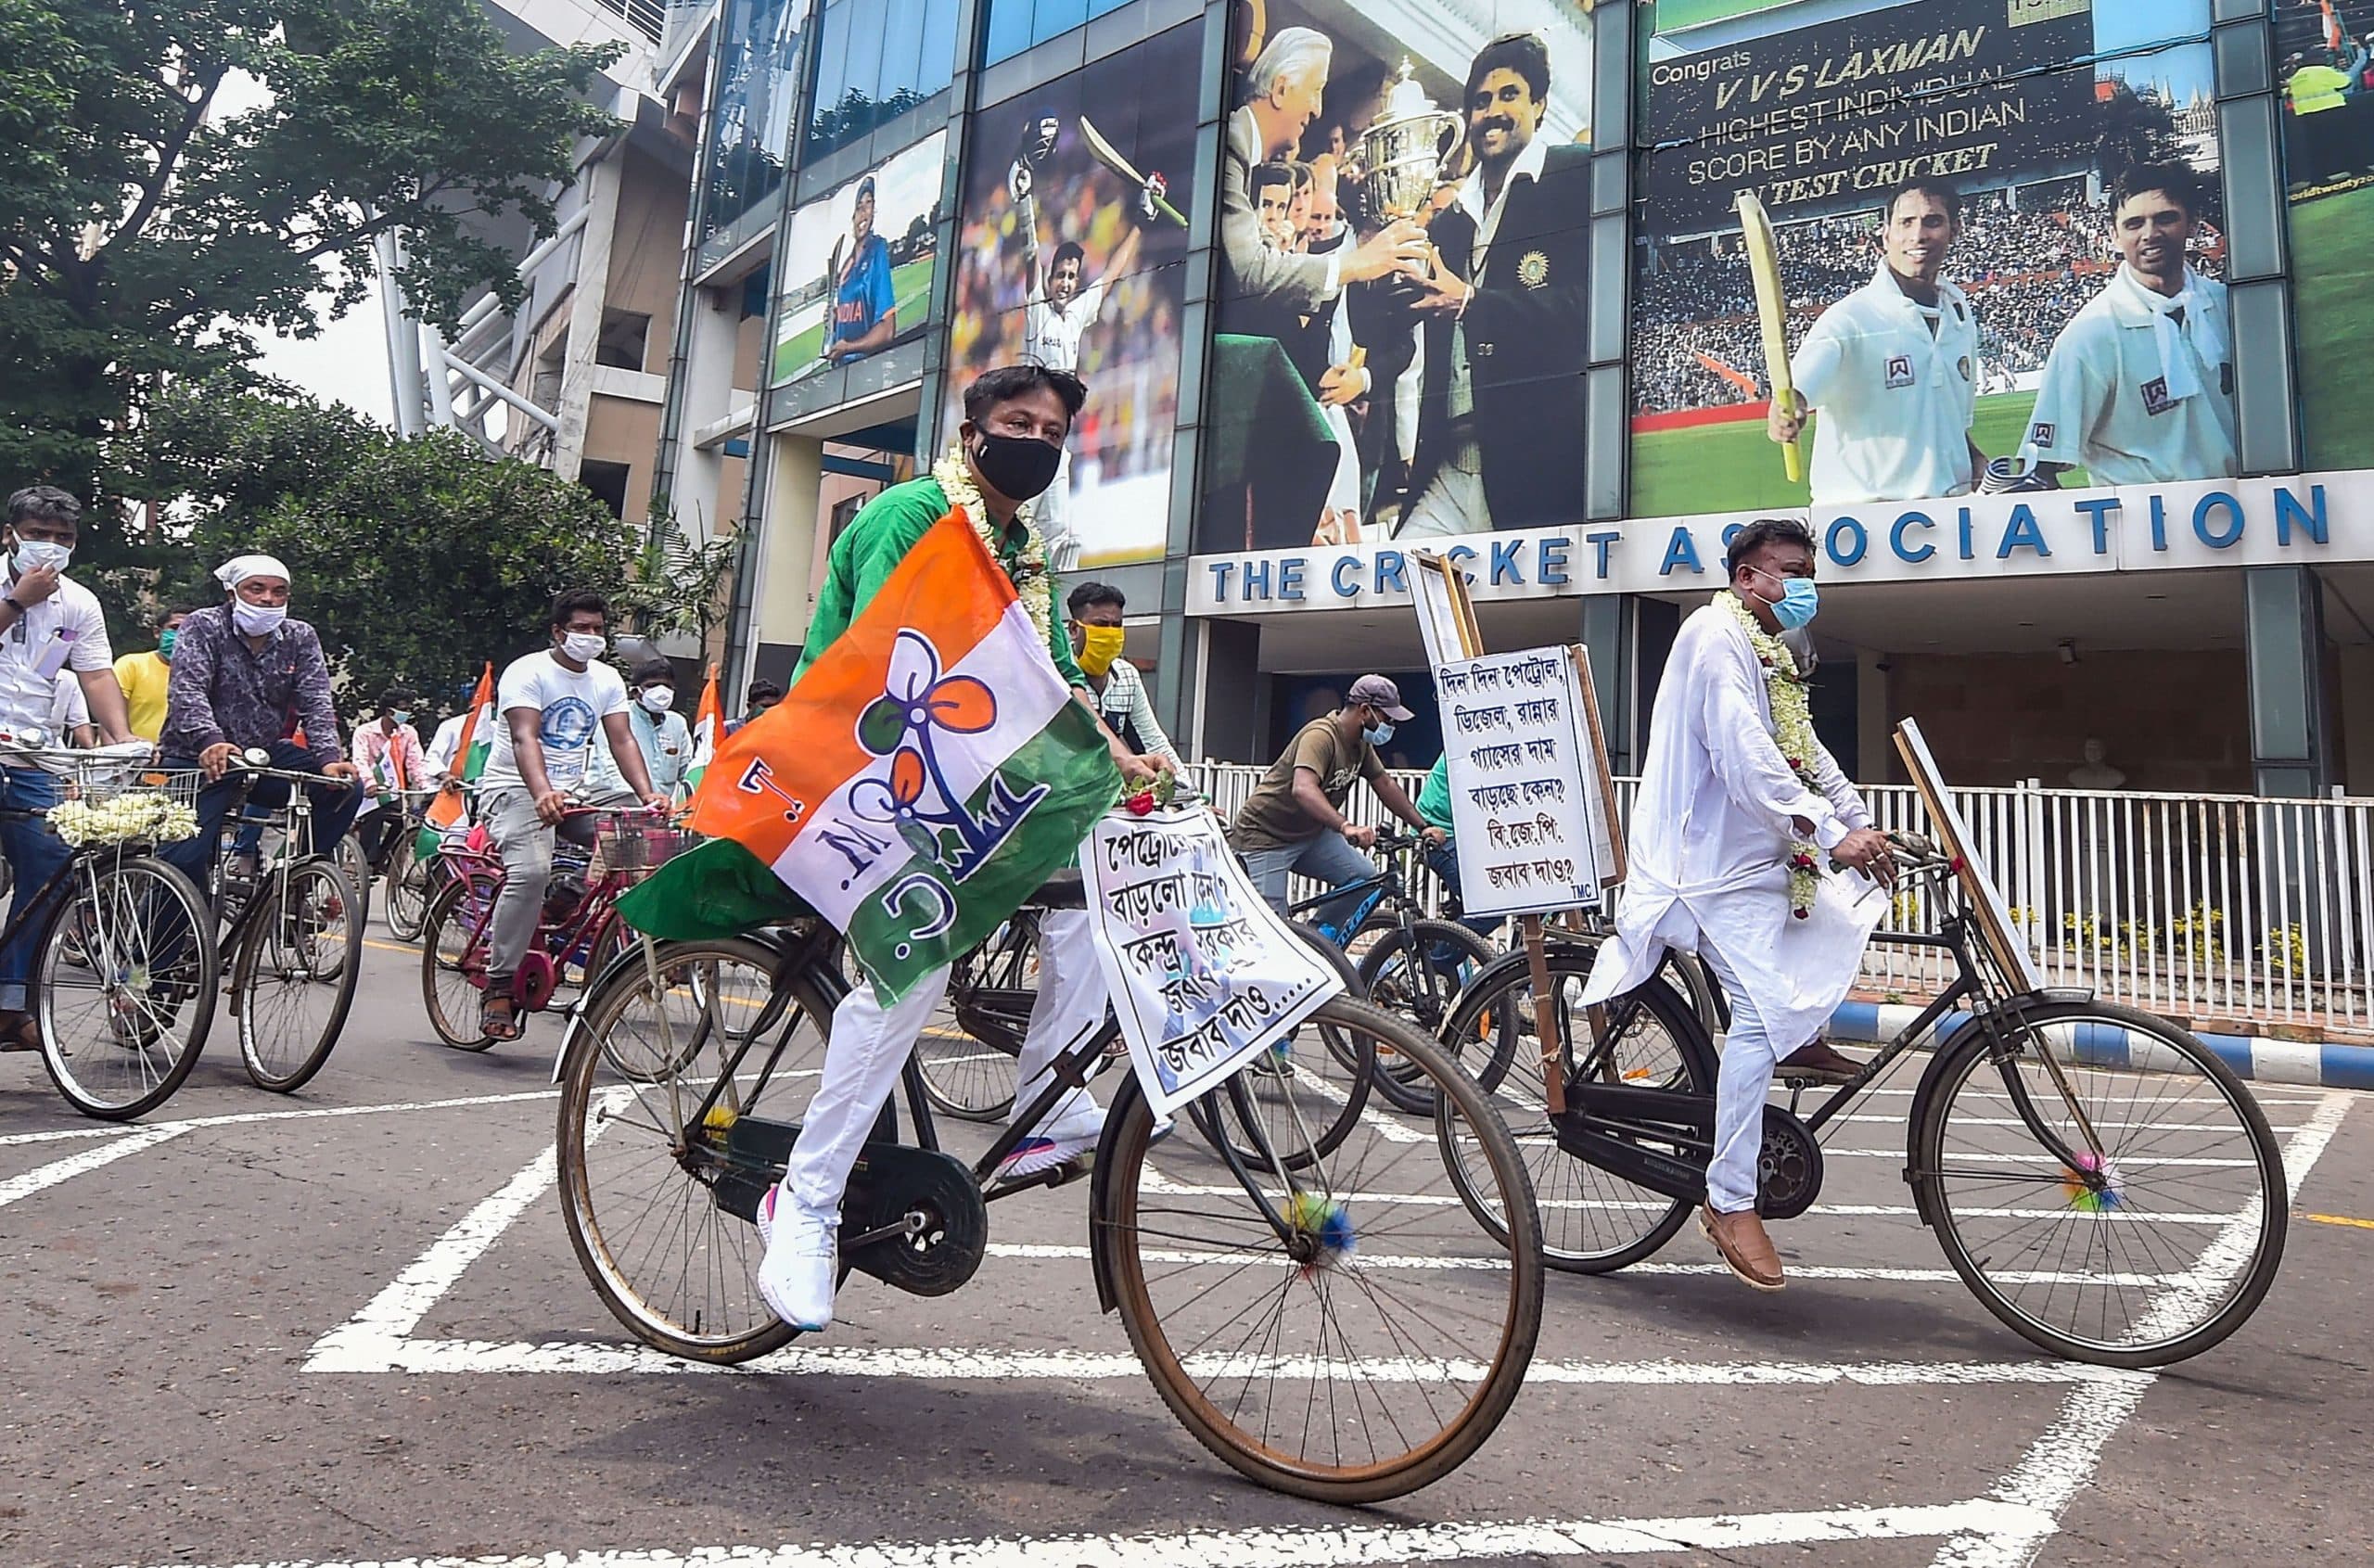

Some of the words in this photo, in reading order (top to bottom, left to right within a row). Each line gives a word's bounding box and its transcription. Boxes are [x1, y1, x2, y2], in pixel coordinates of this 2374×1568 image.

[1653, 51, 1751, 85] Congrats
[1814, 25, 1985, 89] LAXMAN
[1688, 144, 1787, 185] SCORE
[1795, 132, 1835, 165] BY
[1841, 121, 1908, 156] ANY
[1915, 97, 2025, 143] INDIAN
[1700, 99, 1831, 148] HIGHEST
[1770, 171, 1848, 206] TEST
[1853, 143, 1998, 190] CRICKET
[836, 300, 863, 323] NDIA
[1208, 557, 1308, 604] THE
[1331, 530, 1622, 598] CRCKET
[1660, 484, 2329, 577] AOCIATION
[1440, 669, 1469, 697] দিন
[1471, 663, 1500, 693] দিন
[1454, 705, 1514, 734] ডিজেল,
[1515, 697, 1560, 727] রান্নার
[1471, 743, 1522, 771] গ্যাসের
[1525, 738, 1557, 763] দাম
[1469, 781, 1518, 814] বাড়ছে
[1521, 778, 1565, 805] কেন?
[1486, 861, 1531, 889] জবাব
[1532, 859, 1575, 886] দাও?
[1571, 884, 1592, 899] TMC
[1108, 868, 1187, 926] বাড়লো
[1158, 1017, 1229, 1073] জবাব
